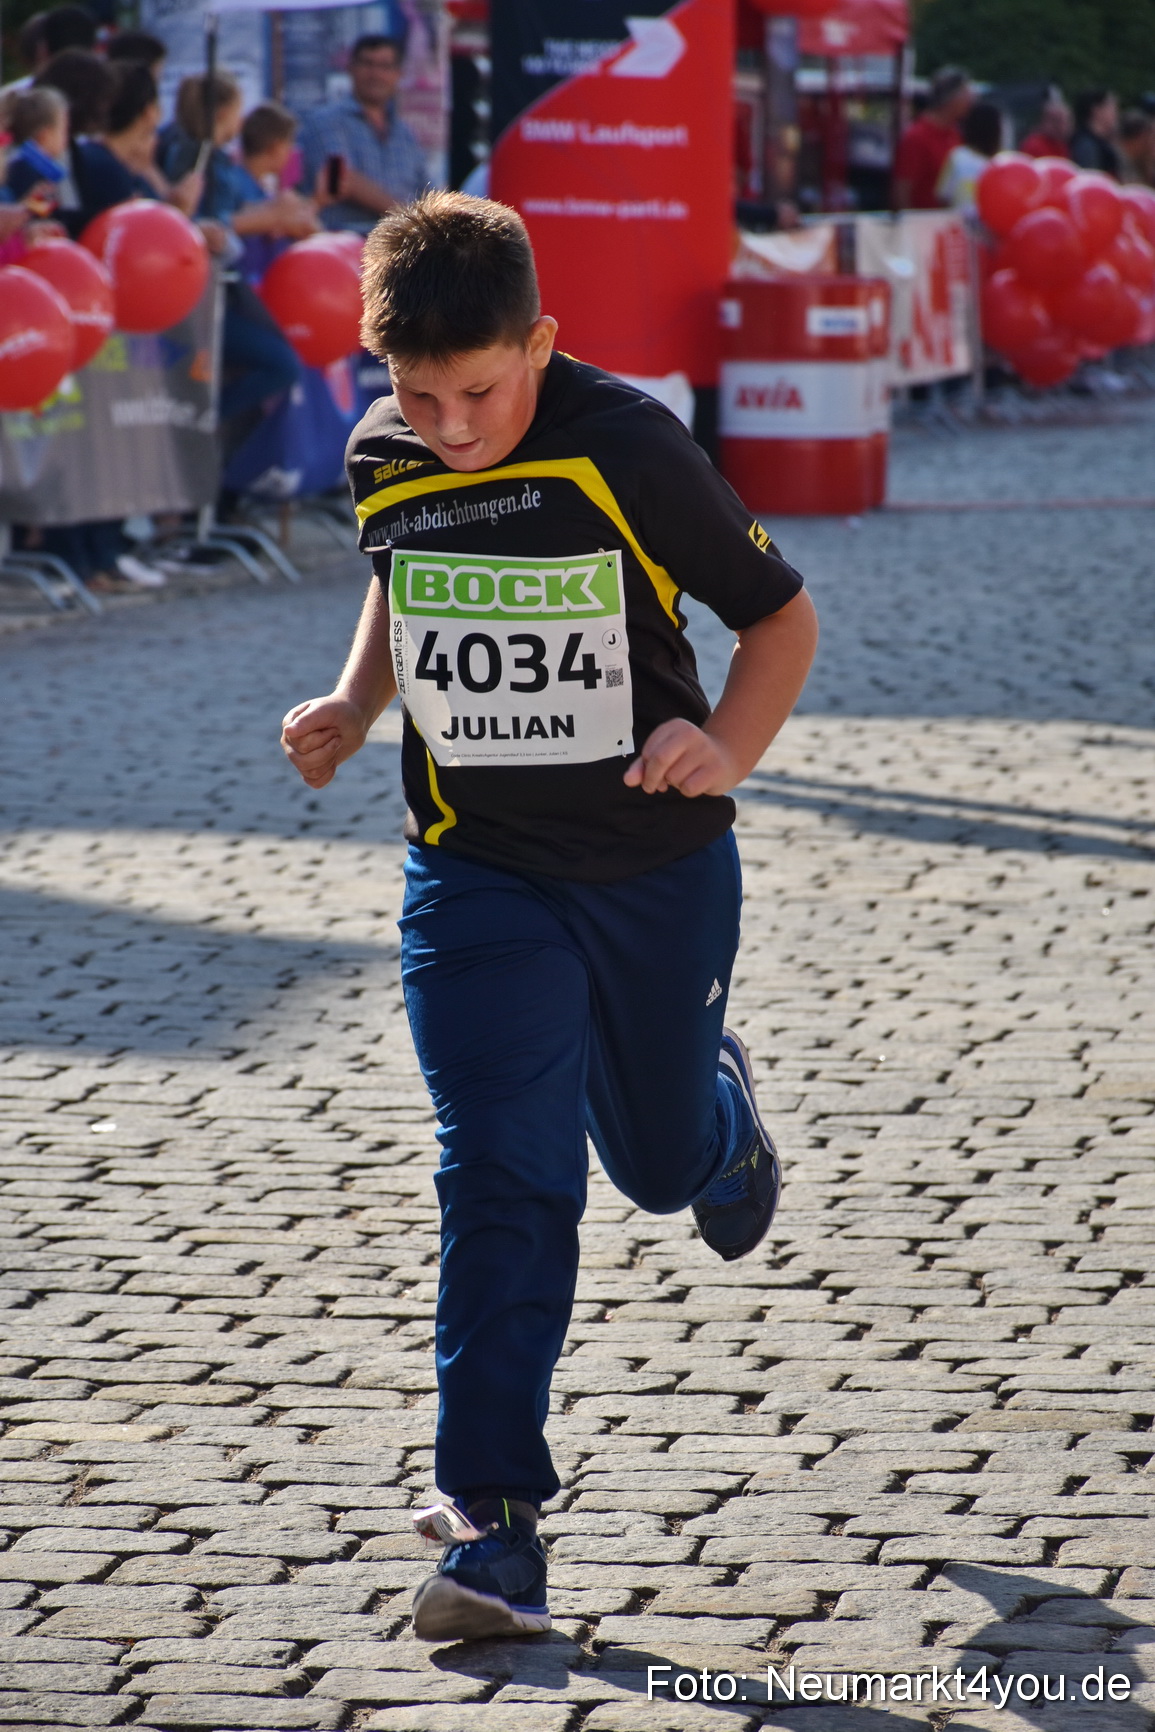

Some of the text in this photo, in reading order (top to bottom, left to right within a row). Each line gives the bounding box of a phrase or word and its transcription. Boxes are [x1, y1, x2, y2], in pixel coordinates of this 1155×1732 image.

[578, 120, 689, 149] Laufsport
[368, 483, 541, 547] www.mk-abdichtungen.de
[408, 564, 603, 611] BOCK
[608, 633, 616, 645] J
[414, 630, 602, 694] 4034
[441, 714, 575, 740] JULIAN
